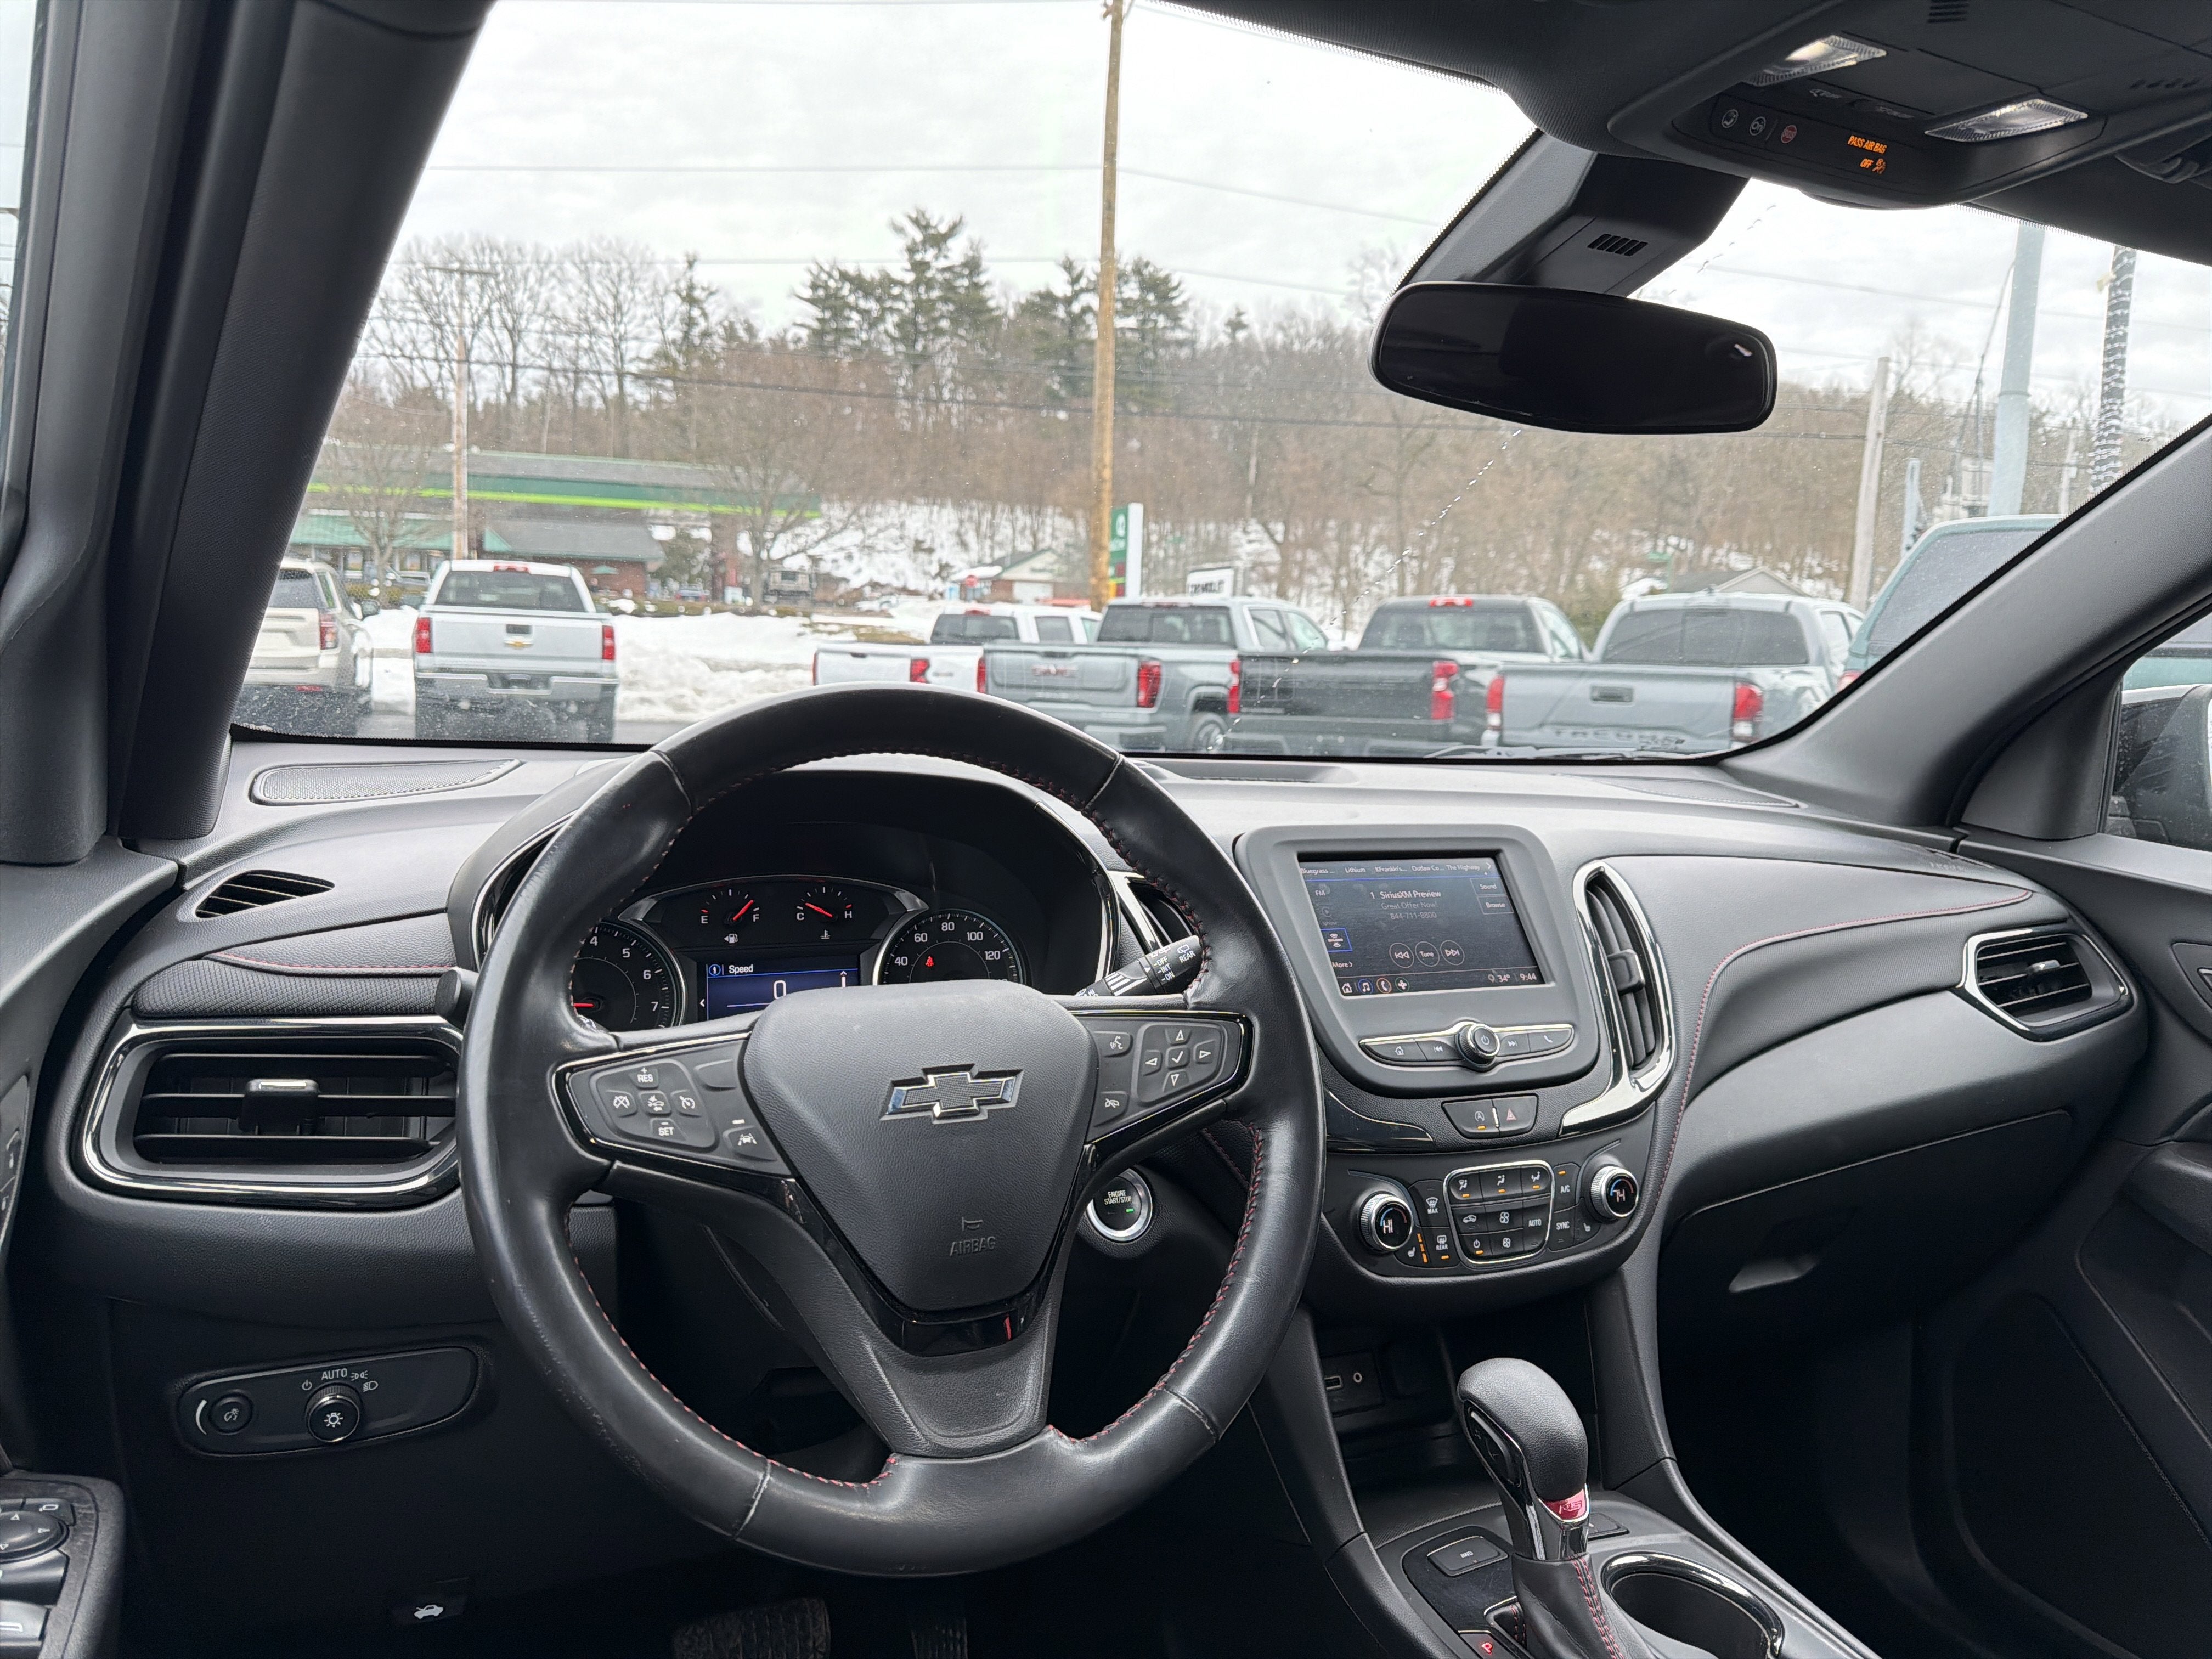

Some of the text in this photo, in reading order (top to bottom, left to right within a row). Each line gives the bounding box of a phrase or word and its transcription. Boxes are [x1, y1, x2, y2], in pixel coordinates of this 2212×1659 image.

[1847, 136, 1887, 154] PASS AIR BAG
[1860, 158, 1874, 168] OFF
[1457, 864, 1480, 872] Highway
[1380, 890, 1412, 899] SiriusXM
[1413, 890, 1441, 898] Preview
[701, 916, 708, 924] E
[753, 914, 760, 922] F
[797, 912, 805, 921] C
[1390, 911, 1437, 920] 844-711-8800
[941, 922, 955, 931] 80
[590, 936, 598, 946] 4
[914, 933, 928, 943] 60
[967, 932, 983, 941] 100
[622, 948, 630, 958] 5
[985, 950, 1001, 960] 120
[1178, 951, 1196, 963] REAR
[894, 956, 908, 966] 40
[1156, 956, 1168, 966] OFF
[729, 964, 754, 974] Speed
[1160, 963, 1171, 974] INT
[643, 969, 651, 980] 6
[1165, 972, 1176, 980] ON
[1520, 973, 1537, 981] 9:44
[651, 1001, 659, 1011] 7
[637, 1074, 653, 1082] RES
[658, 1127, 674, 1136] SET
[1108, 1190, 1126, 1198] ENGINE
[1560, 1185, 1571, 1193] A/C
[1104, 1195, 1132, 1205] START/STOP
[1383, 1218, 1393, 1234] HI
[1528, 1218, 1542, 1227] AUTO
[1556, 1221, 1570, 1231] SYNC
[950, 1236, 996, 1256] AIRBAG
[321, 1368, 348, 1381] AUTO
[1482, 1642, 1493, 1654] P
